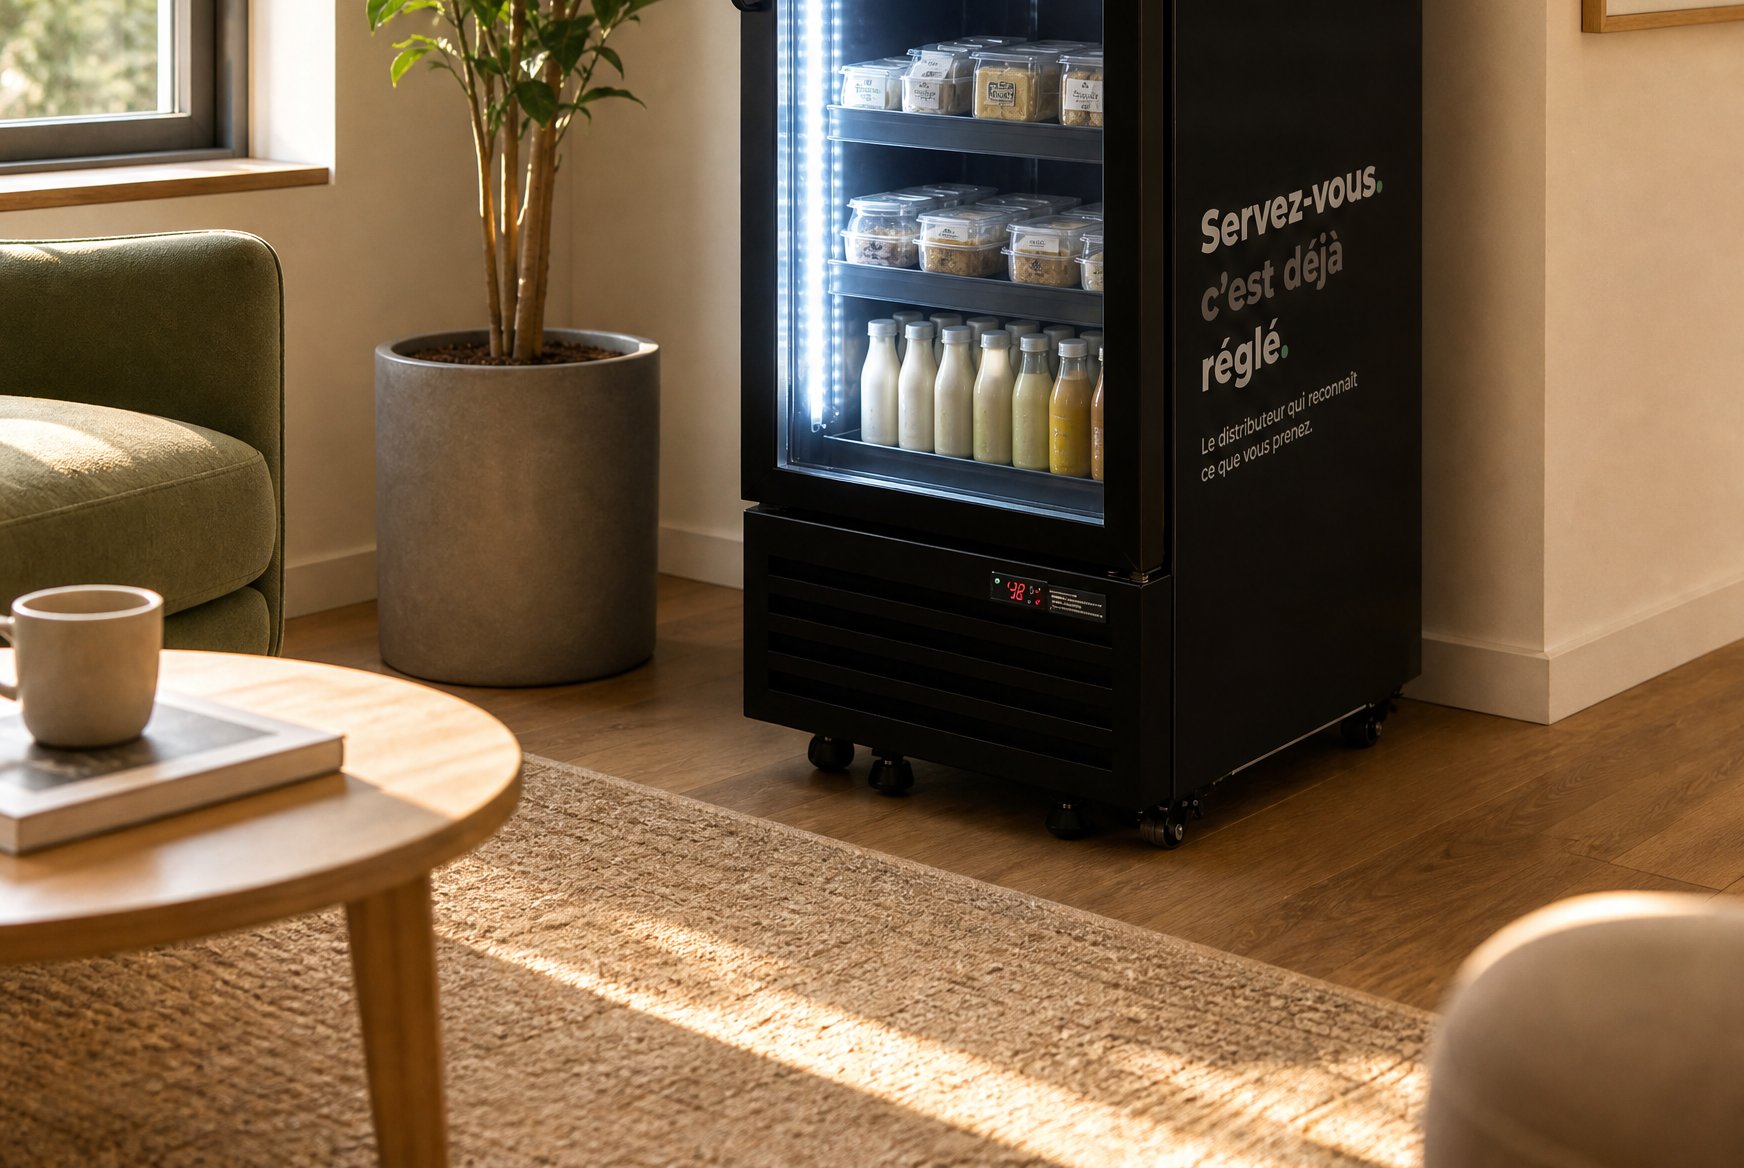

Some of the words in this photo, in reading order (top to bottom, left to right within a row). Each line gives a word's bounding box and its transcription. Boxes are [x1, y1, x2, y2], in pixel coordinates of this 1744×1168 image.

[1201, 165, 1383, 254] Servez-vous.
[1201, 260, 1275, 322] c’est
[1283, 230, 1343, 290] déjà
[1201, 317, 1289, 393] réglé.
[1201, 437, 1216, 456] Le
[1218, 403, 1286, 446] distributeur
[1287, 391, 1306, 422] qui
[1201, 465, 1216, 483] ce
[1217, 449, 1241, 480] que
[1243, 440, 1271, 464] vous
[1272, 418, 1314, 455] prenez.
